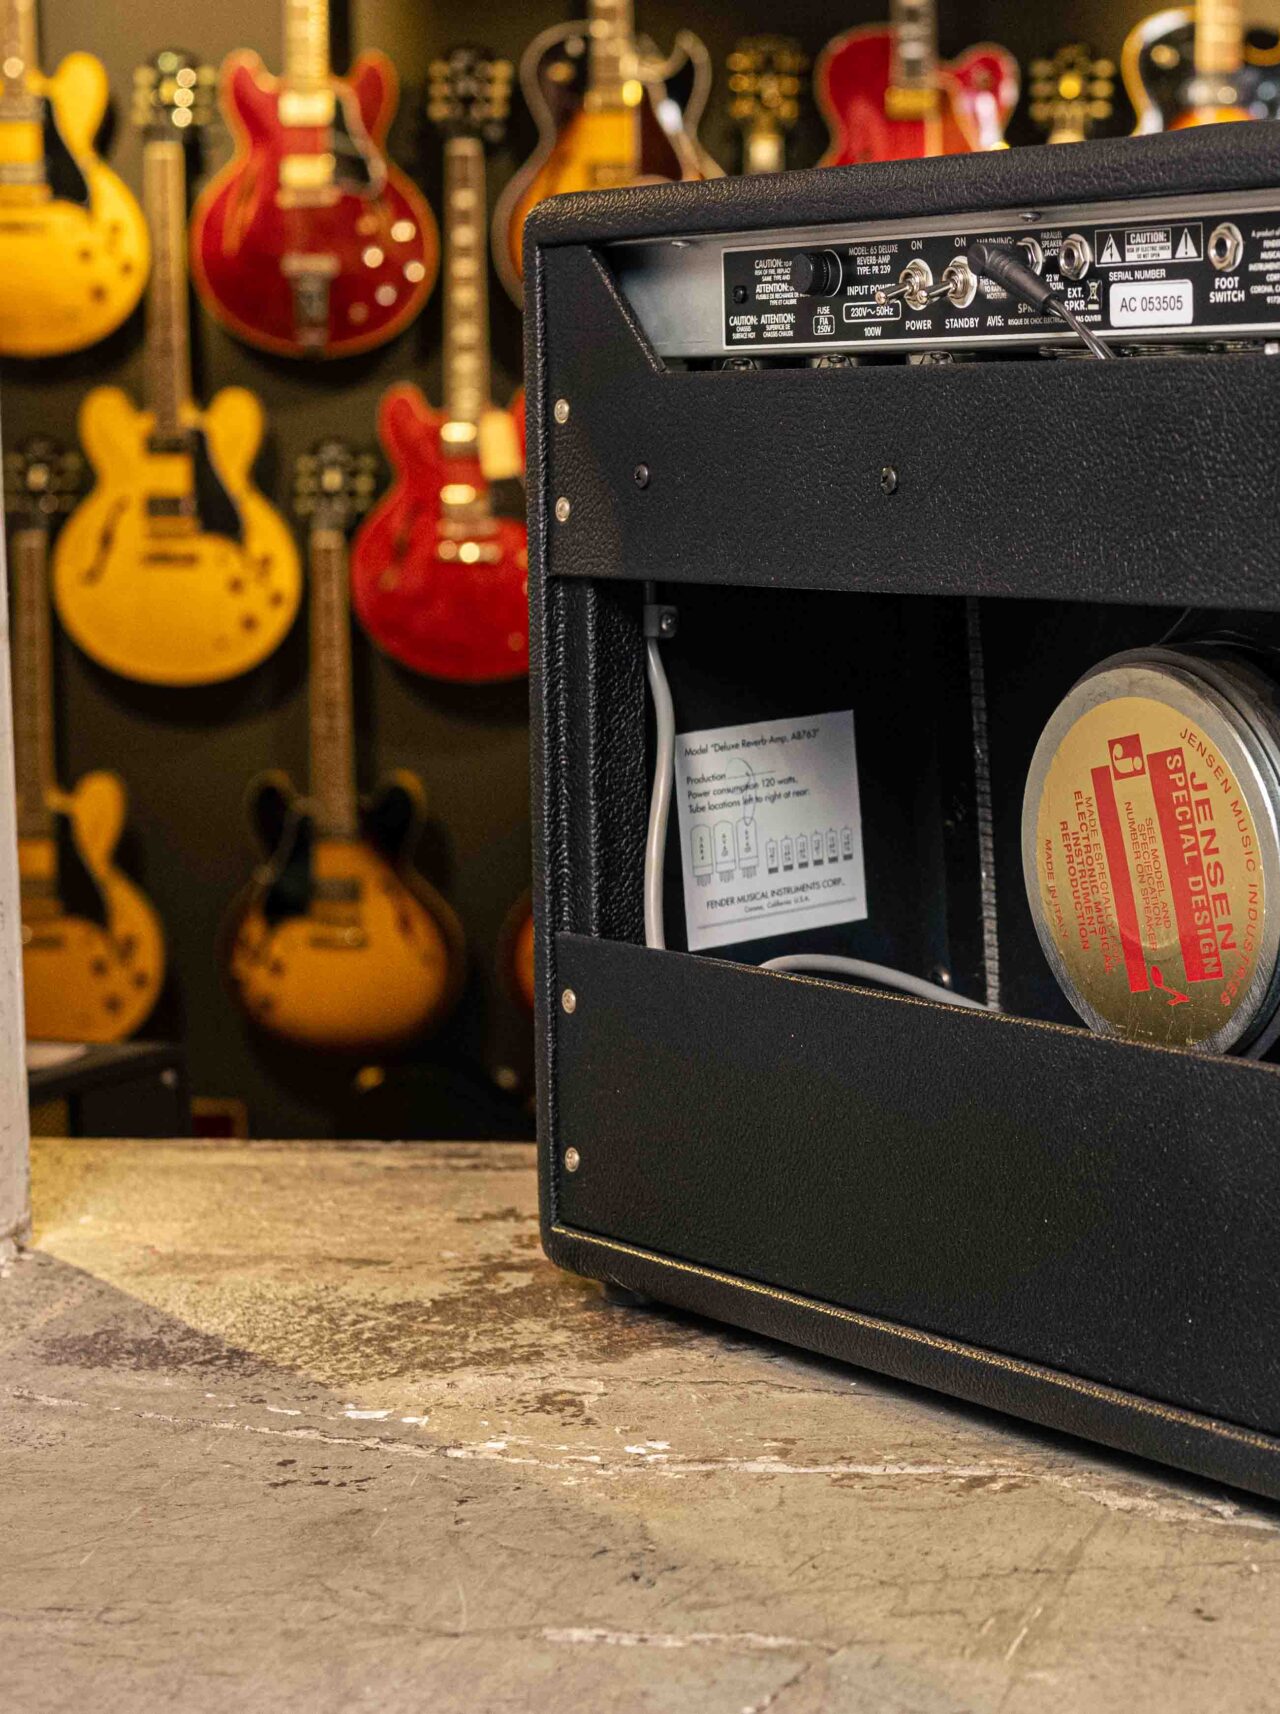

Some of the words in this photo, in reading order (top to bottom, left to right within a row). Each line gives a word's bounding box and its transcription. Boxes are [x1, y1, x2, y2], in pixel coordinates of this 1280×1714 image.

[954, 237, 967, 247] ON
[1041, 240, 1063, 248] SPEAKER
[1130, 231, 1167, 244] CAUTION:
[848, 247, 869, 256] MODEL:
[870, 246, 878, 254] 65
[878, 244, 899, 254] DELUXE
[911, 241, 923, 250] ON
[754, 258, 783, 269] CAUTION:
[857, 266, 871, 275] TYPE:
[872, 266, 879, 275] PR
[880, 265, 891, 274] 239
[1046, 274, 1053, 282] 22
[1053, 274, 1060, 282] W
[1109, 271, 1133, 281] SERIAL
[1134, 269, 1166, 280] NUMBER
[1215, 277, 1240, 289] FOOT
[847, 285, 869, 296] INPUT
[1067, 287, 1084, 298] EXT.
[1209, 290, 1245, 303] SWITCH
[817, 306, 830, 314] FUSE
[1064, 301, 1088, 311] SPKR.
[1120, 297, 1137, 312] AC
[1141, 296, 1183, 311] 053505
[729, 315, 758, 326] CAUTION:
[760, 313, 796, 324] ATTENTION:
[945, 318, 980, 329] STANDBY
[986, 315, 1004, 327] AVIS:
[817, 325, 832, 333] 250V
[864, 327, 882, 336] 100W
[905, 320, 932, 331] POWER
[684, 744, 708, 757] Model
[686, 773, 726, 786] Production
[687, 790, 710, 800] Power
[713, 783, 759, 797] consumption
[762, 777, 776, 788] 120
[689, 802, 706, 814] Tube
[708, 798, 740, 811] locations
[755, 795, 763, 804] to
[764, 791, 782, 805] right
[783, 791, 791, 800] at
[1180, 728, 1232, 794] JENSEN
[1230, 801, 1256, 872] MUSIC
[1124, 801, 1142, 860] NUMBER
[1145, 817, 1157, 846] SEE
[1045, 839, 1055, 881] MADE
[1085, 796, 1099, 837] MADE
[1093, 843, 1115, 929] ESPECIALLY
[1166, 754, 1198, 865] SPECIAL
[1188, 875, 1221, 974] DESIGN
[1190, 771, 1237, 950] JENSEN
[1136, 863, 1147, 884] ON
[1137, 823, 1162, 927] SPECIFICATION
[1150, 848, 1164, 898] MODEL
[1060, 820, 1091, 950] REPRODUCTION
[1071, 831, 1098, 936] INSTRUMENT
[1074, 790, 1099, 895] ELECTRONIC
[1094, 901, 1115, 976] MUSICAL
[706, 897, 735, 911] FENDER
[737, 892, 769, 905] MUSICAL
[771, 883, 821, 899] INSTRUMENTS
[1049, 885, 1058, 898] IN
[1140, 889, 1158, 952] SPEAKER
[1161, 901, 1172, 929] AND
